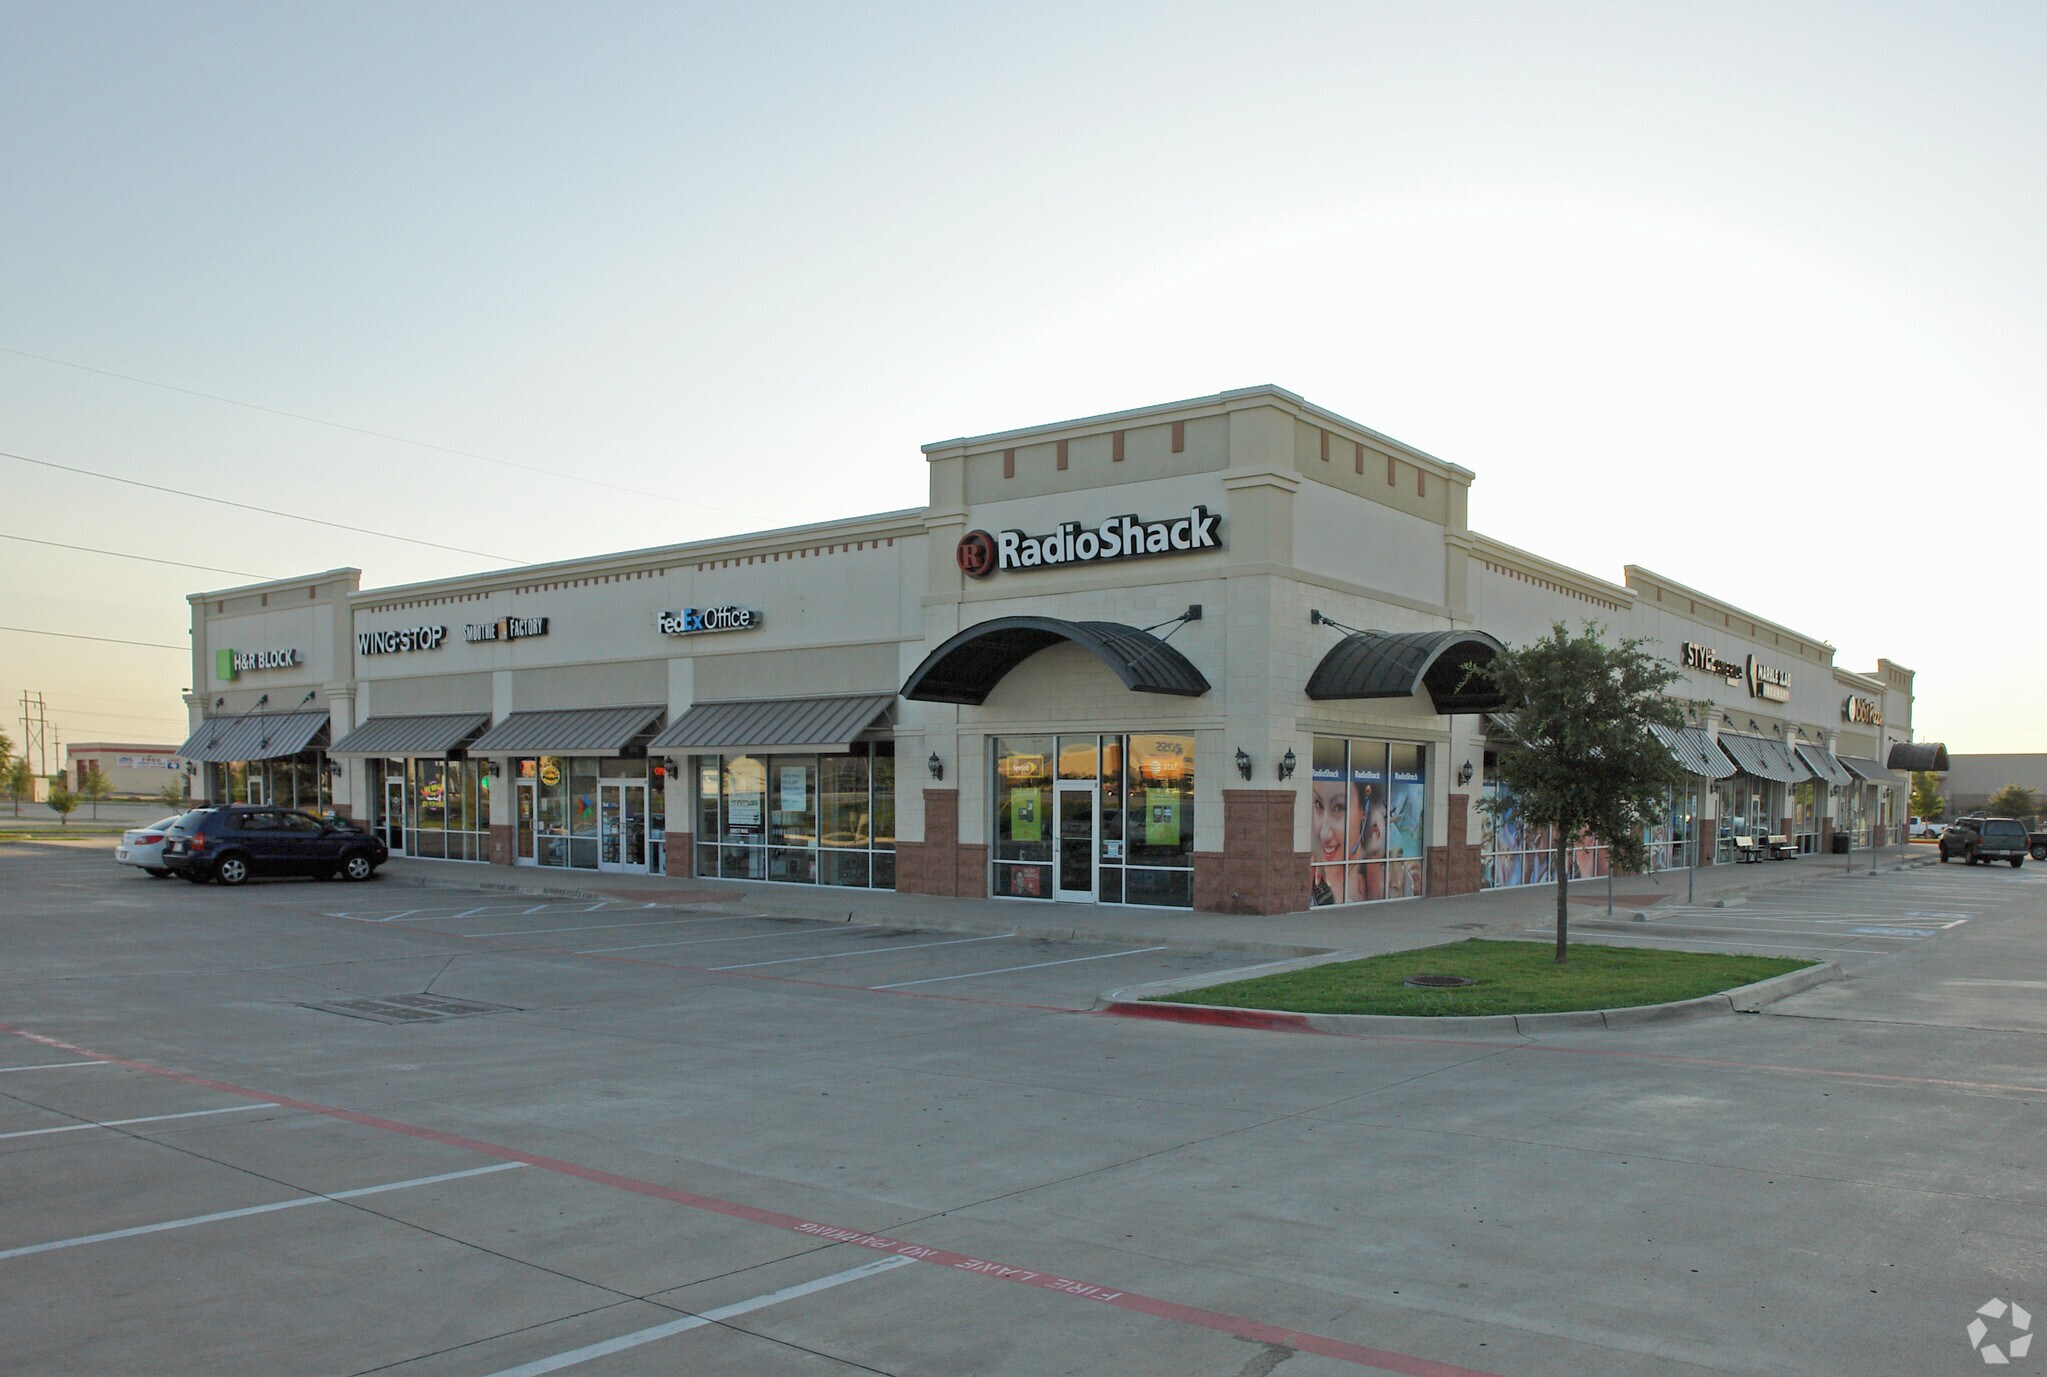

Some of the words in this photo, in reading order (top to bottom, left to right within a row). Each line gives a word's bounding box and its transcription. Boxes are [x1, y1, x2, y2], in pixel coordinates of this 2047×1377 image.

[998, 507, 1215, 569] RadioShack
[462, 623, 496, 642] SMOOTHIE
[509, 617, 543, 637] FACTORY
[657, 609, 703, 634] FedEx
[703, 606, 751, 629] Office
[234, 653, 257, 672] H&R
[257, 648, 294, 670] BLOCK
[1355, 770, 1380, 779] RadioShack
[1395, 772, 1418, 781] RadioShack
[794, 1222, 899, 1250] PARKING
[896, 1245, 940, 1259] NO
[954, 1258, 1040, 1282] LANE
[1045, 1278, 1123, 1302] FIRE
